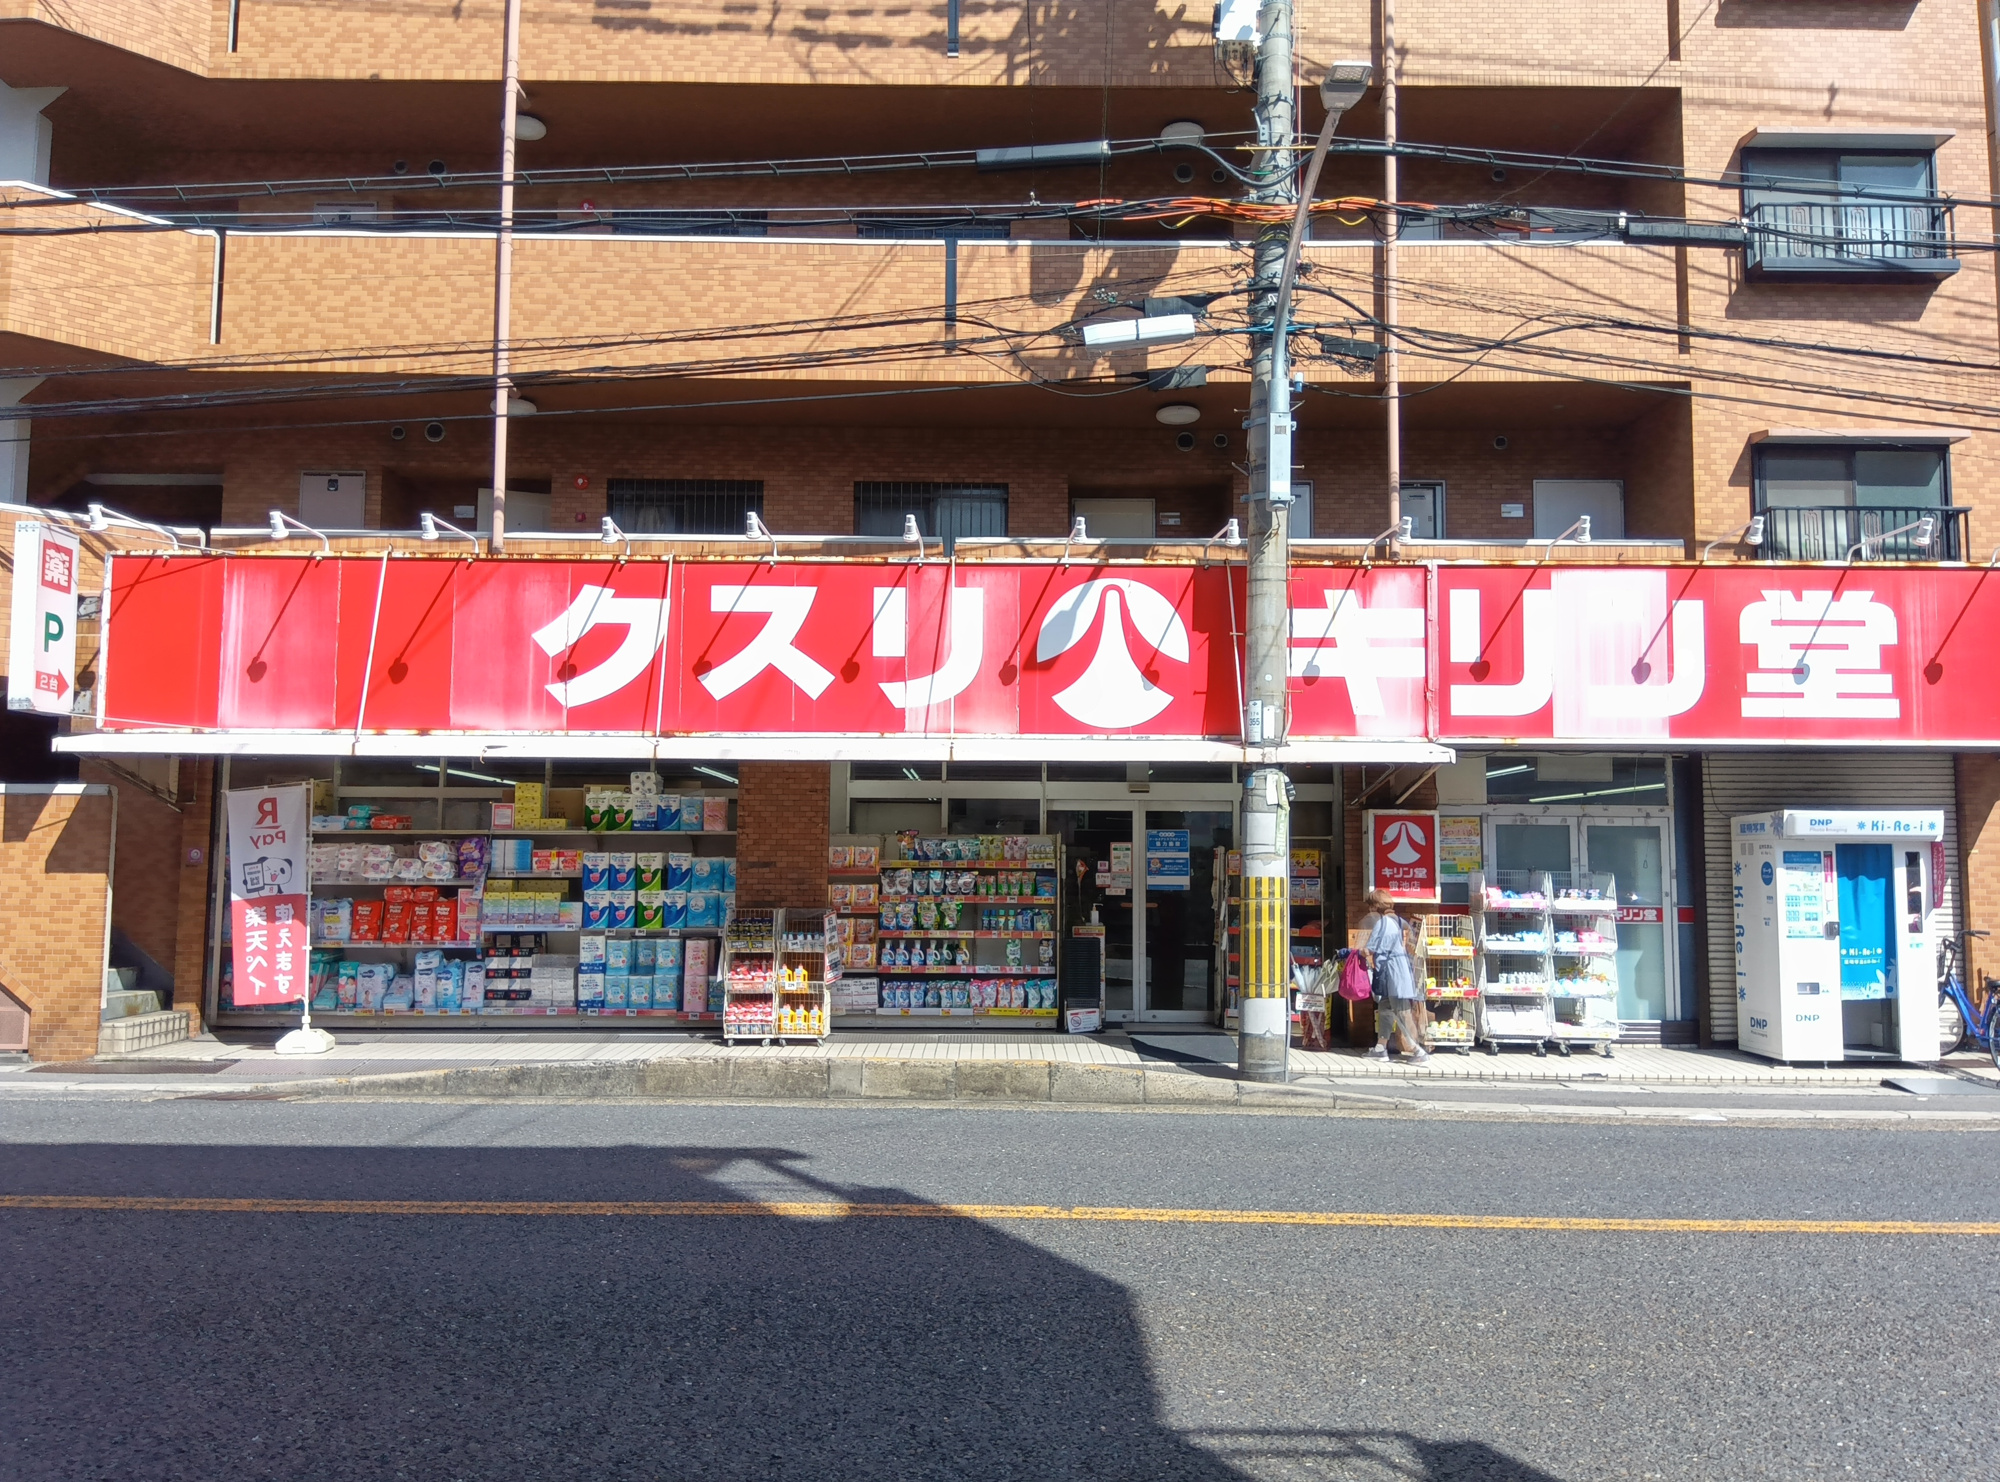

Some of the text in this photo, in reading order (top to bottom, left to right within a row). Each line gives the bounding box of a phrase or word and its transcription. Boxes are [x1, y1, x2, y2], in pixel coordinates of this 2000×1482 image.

[45, 548, 70, 587] 薬
[44, 611, 64, 653] P
[531, 583, 984, 709] クスリ
[39, 674, 59, 690] 2台
[1739, 822, 1766, 834] 証明写真
[1381, 866, 1428, 879] キリン堂
[1614, 908, 1657, 921] キリン堂
[1750, 1016, 1768, 1030] DNP
[1795, 1014, 1820, 1022] DNP
